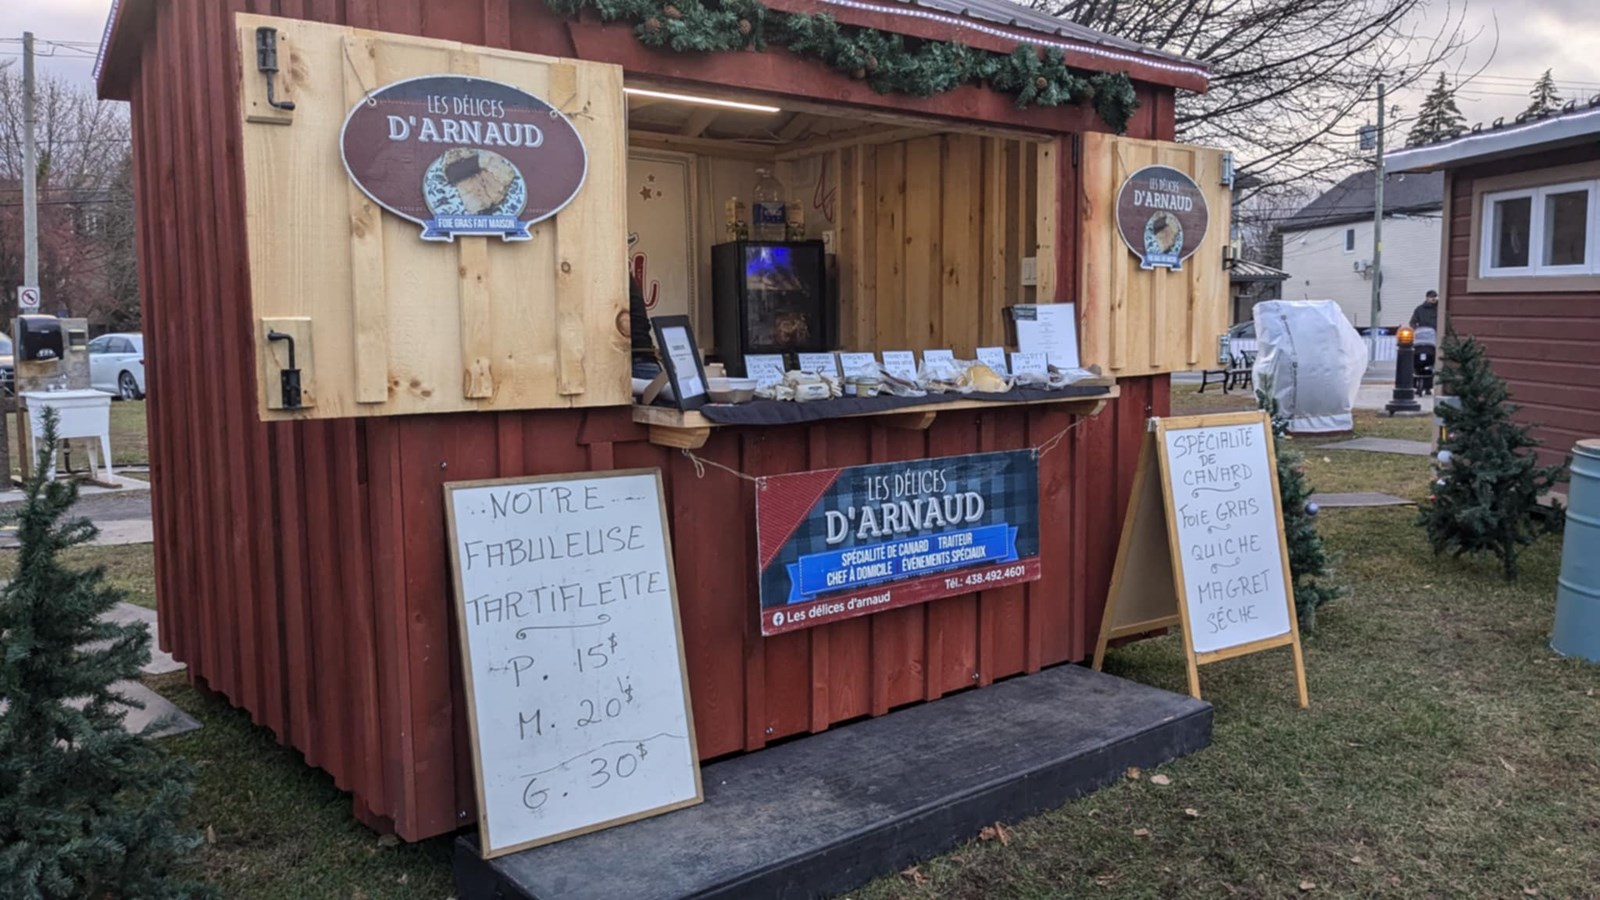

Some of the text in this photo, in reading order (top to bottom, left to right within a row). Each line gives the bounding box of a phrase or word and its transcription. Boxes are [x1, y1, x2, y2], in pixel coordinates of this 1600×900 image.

[427, 94, 505, 118] LES DÉLICES
[387, 115, 544, 147] D'ARNAUD
[1134, 190, 1193, 211] D'ARNAUD
[438, 218, 515, 229] FOIE GRAS FAIT MAISON
[1184, 464, 1253, 486] CANARD
[1199, 454, 1216, 467] DE
[868, 469, 947, 501] LES DÉLICES
[825, 491, 985, 545] D'ARNAUD
[1179, 498, 1260, 529] FOIE GRAS
[464, 525, 645, 570] FABULEUSE
[841, 532, 973, 567] SPÉCIALITÉ DE CANARD TRAITEUR
[1192, 535, 1261, 561] QUICHE
[827, 545, 987, 586] CHEF À DOMICILE ÉVÉNEMENTS SPÉCIAUX
[965, 565, 1026, 586] 438.492.4601
[1198, 569, 1270, 604] MAGRET
[787, 591, 891, 623] Les délices d'arnaud
